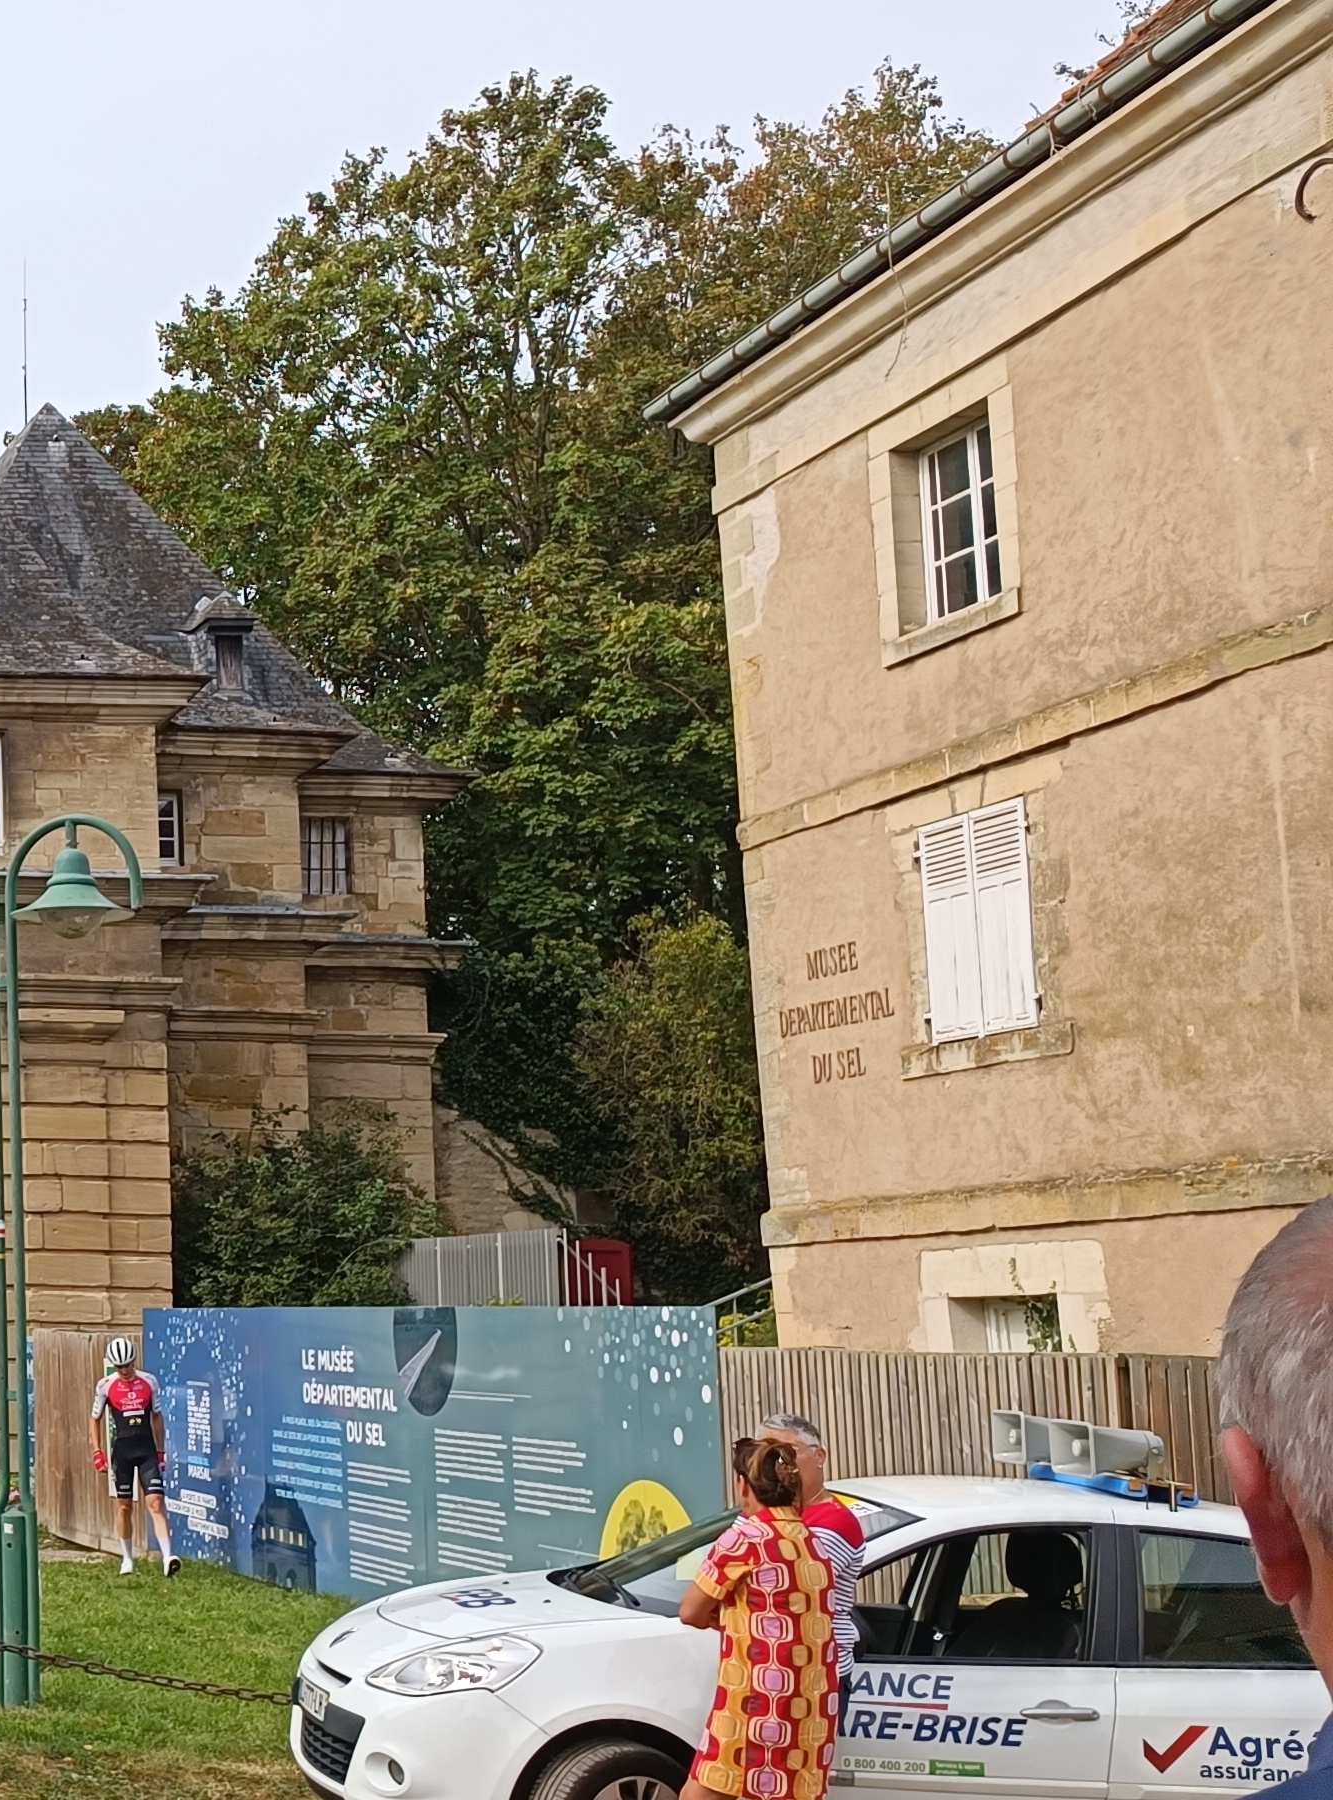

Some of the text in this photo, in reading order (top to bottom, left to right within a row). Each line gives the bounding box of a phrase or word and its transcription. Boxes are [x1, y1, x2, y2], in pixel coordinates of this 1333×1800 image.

[806, 941, 859, 981] MUSEE
[778, 988, 895, 1038] DEPARTEMENTAL
[811, 1047, 866, 1084] DU SEL
[301, 1345, 354, 1373] LE MUSÉE
[302, 1377, 398, 1412] DÉPARTEMENTAL
[346, 1420, 386, 1447] DU SEL
[852, 1671, 954, 1699] ANCE
[1208, 1726, 1318, 1766] Agré
[843, 1758, 926, 1772] 0 800 400 200
